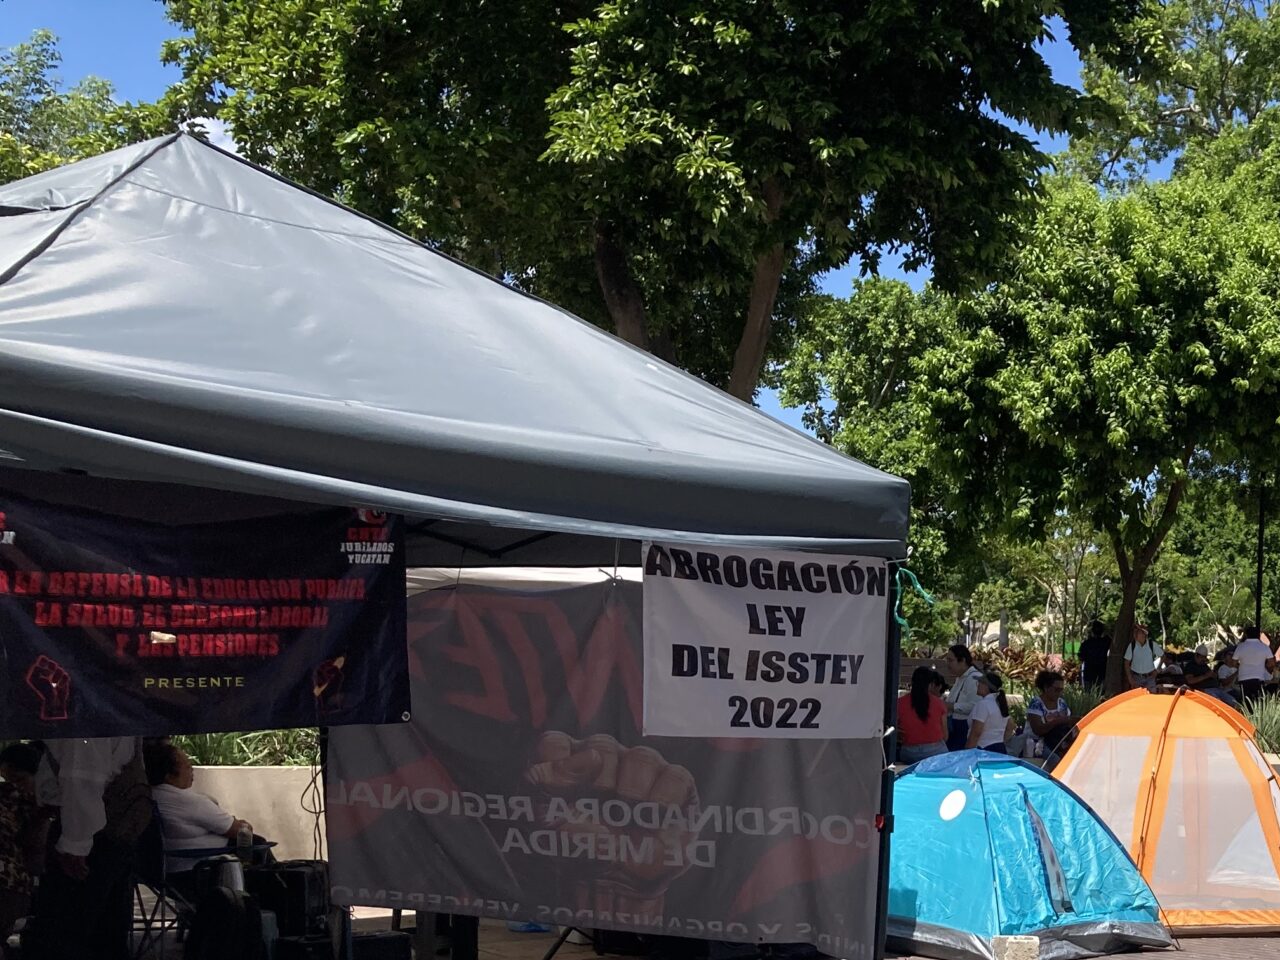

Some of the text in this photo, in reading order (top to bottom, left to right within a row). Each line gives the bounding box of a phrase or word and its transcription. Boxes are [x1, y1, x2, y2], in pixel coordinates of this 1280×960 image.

[14, 571, 42, 593] LA
[48, 572, 144, 598] DEFENSA
[147, 575, 172, 598] DE
[176, 576, 197, 598] LA
[645, 544, 887, 597] ABROGACIÓN
[35, 601, 62, 626] LA
[142, 604, 166, 627] EL
[746, 603, 806, 637] LEY
[671, 643, 865, 685] DEL ISSTEY
[144, 676, 245, 689] PRESENTE
[728, 695, 822, 729] 2022
